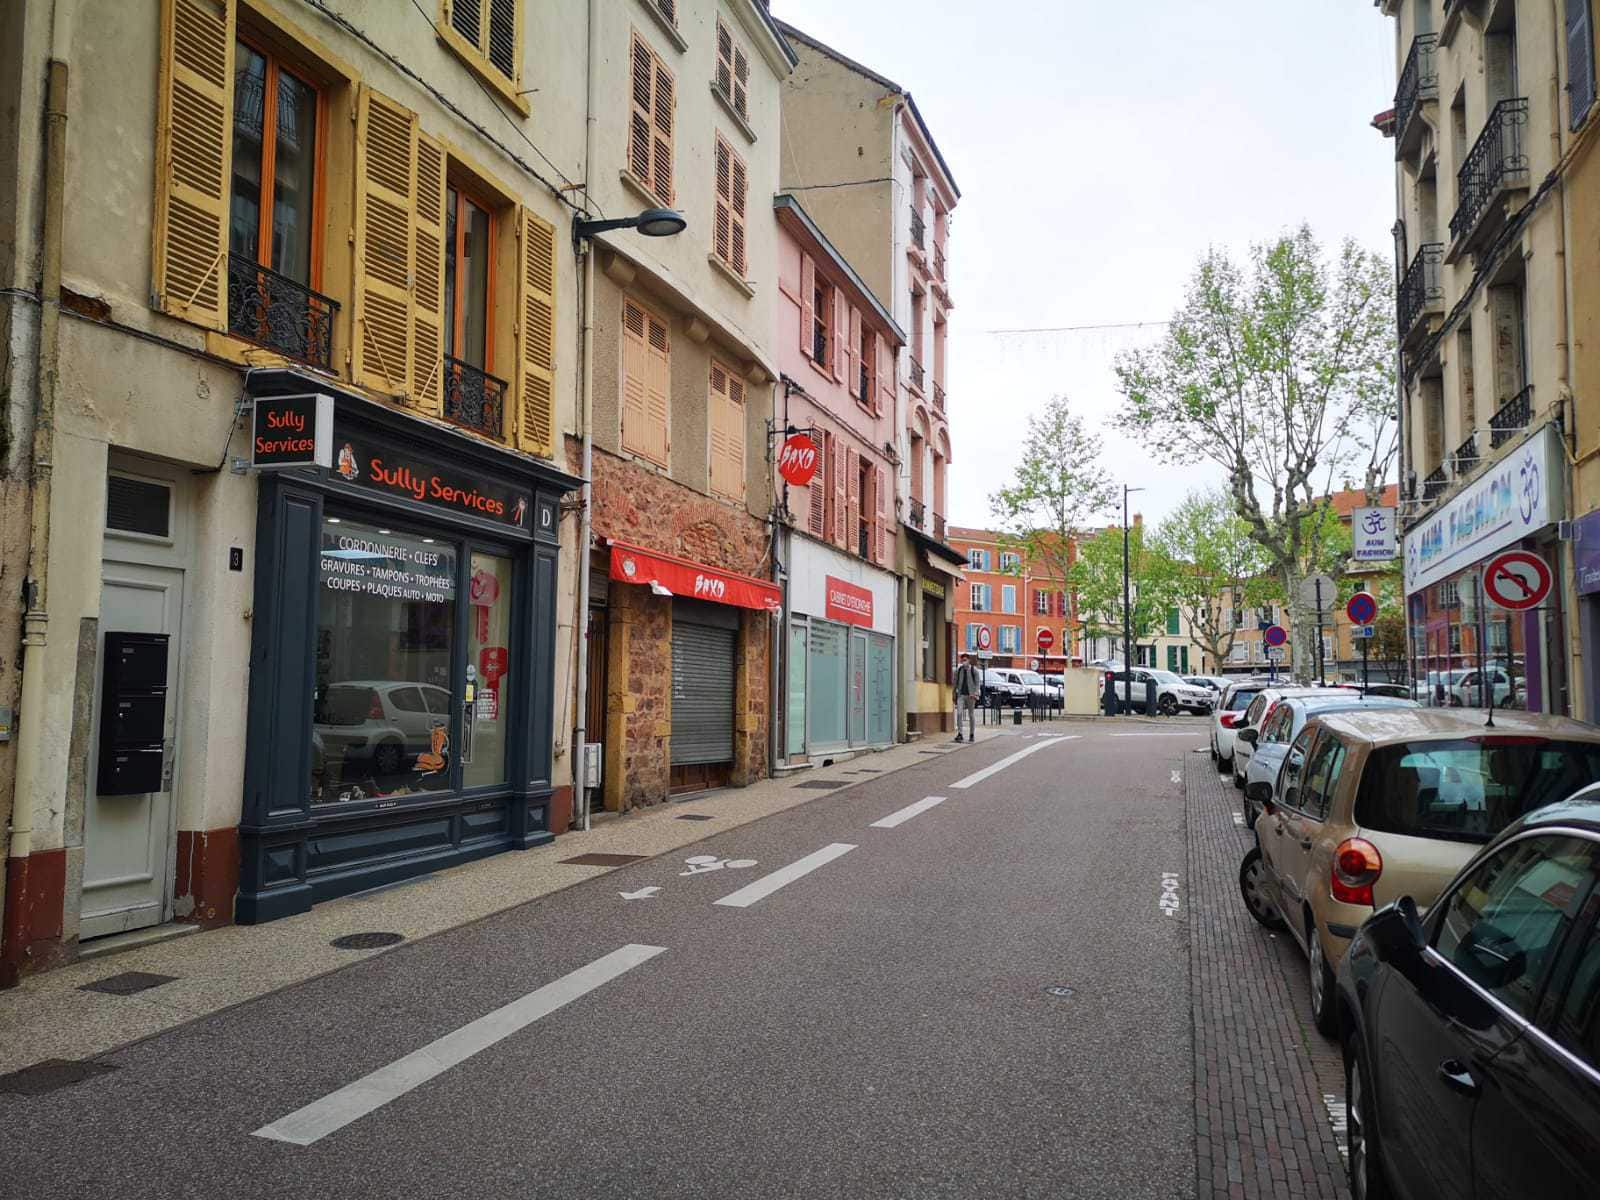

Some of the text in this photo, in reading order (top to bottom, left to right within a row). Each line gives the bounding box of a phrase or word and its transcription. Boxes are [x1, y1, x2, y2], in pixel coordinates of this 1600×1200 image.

[267, 411, 305, 432] Sully
[256, 436, 314, 454] Services
[370, 458, 504, 515] Sully Services
[339, 536, 439, 567] CORDONNERIE CLEFS
[320, 559, 366, 577] GRAVURES
[371, 566, 410, 584] TAMPONS
[327, 576, 445, 604] COUPES PLAQUES AUTO MOTO
